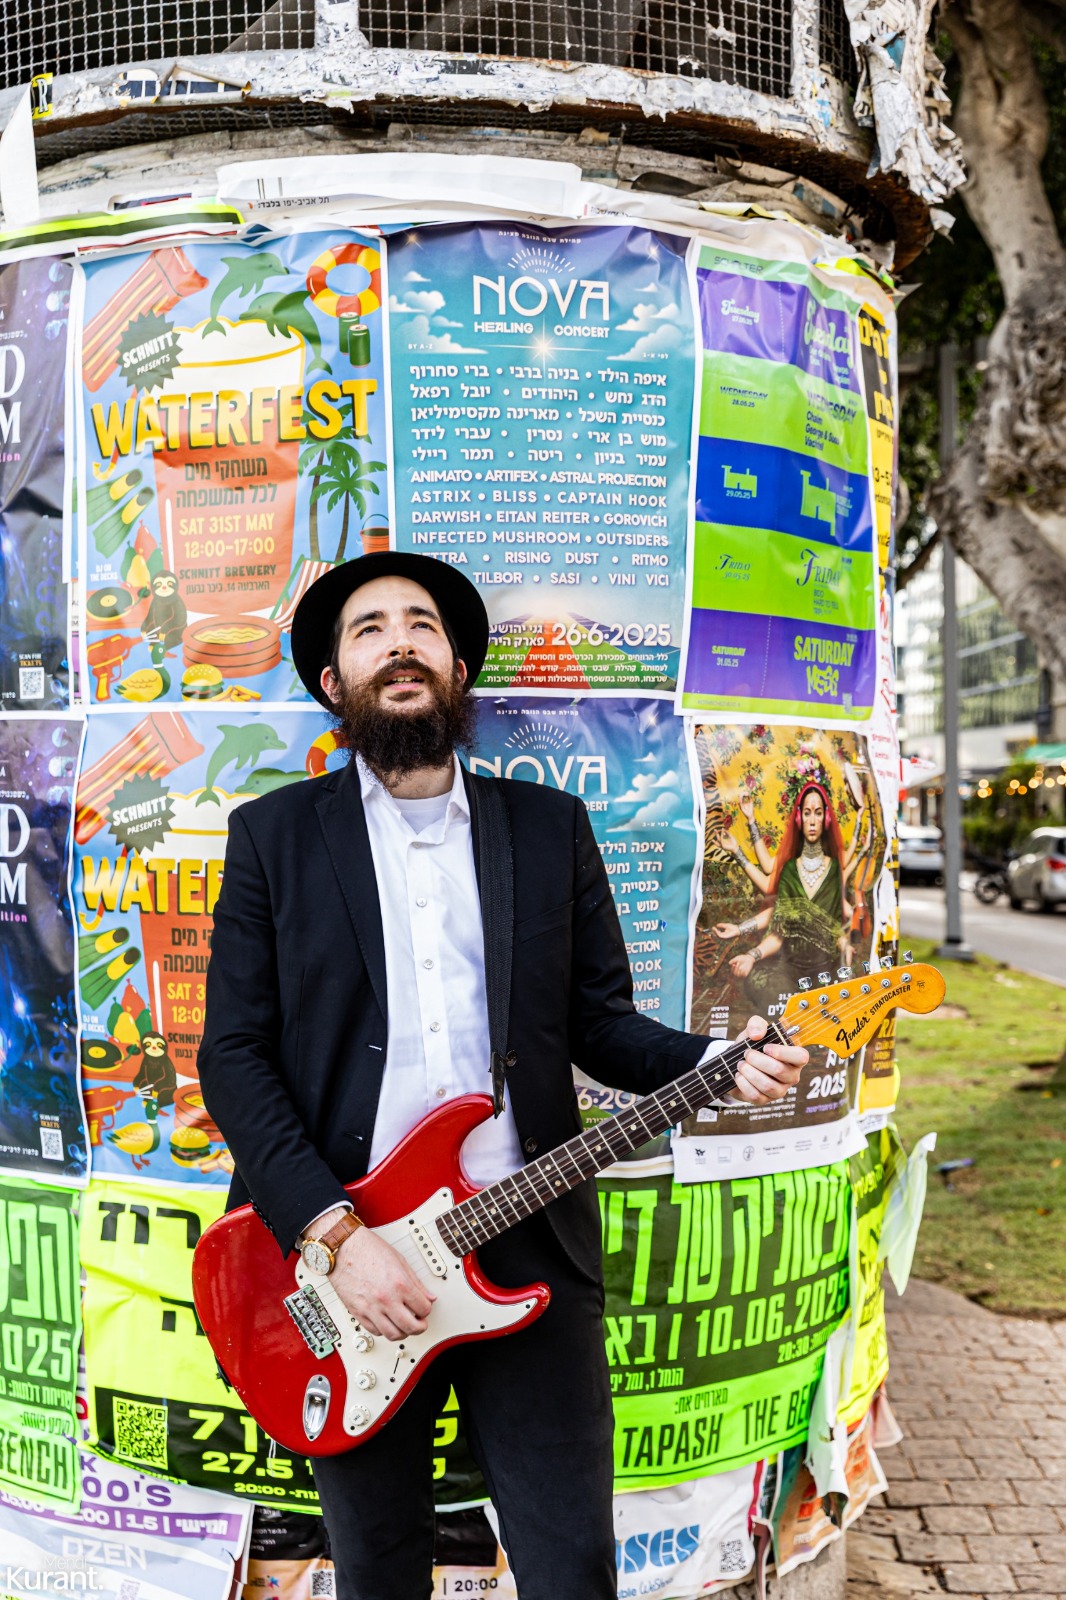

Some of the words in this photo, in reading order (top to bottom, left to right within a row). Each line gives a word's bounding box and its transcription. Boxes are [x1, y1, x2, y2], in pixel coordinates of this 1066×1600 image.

[283, 197, 317, 207] אביב-יפו
[318, 196, 330, 204] תל
[473, 275, 610, 320] NOVA
[474, 321, 534, 334] HEALING
[553, 324, 610, 339] CONCERT
[122, 331, 174, 369] SCHNITT
[136, 353, 171, 376] PRESENTS
[409, 365, 459, 379] סחרוף
[464, 364, 490, 378] ברי
[509, 366, 543, 380] ברבי
[548, 367, 580, 381] בניה
[598, 368, 629, 384] הילד
[633, 371, 667, 386] איפה
[409, 383, 450, 399] רפאל
[460, 383, 491, 399] יובל
[521, 388, 579, 401] היהודים
[720, 386, 768, 400] WEDNESDAY
[605, 392, 633, 406] נחש
[641, 393, 667, 407] הדג
[91, 379, 378, 460] WATERFEST
[410, 403, 501, 422] מקסימיליאן
[506, 406, 560, 421] מארינה
[578, 408, 617, 425] השכל
[621, 413, 666, 427] כנסיית
[411, 424, 446, 441] לידר
[455, 426, 491, 441] עברי
[526, 428, 563, 443] נסרין
[587, 430, 610, 444] ארי
[618, 433, 634, 447] בן
[640, 433, 667, 447] מוש
[412, 445, 448, 461] ריילי
[460, 446, 494, 461] תמר
[527, 448, 563, 462] ריטה
[594, 451, 626, 466] בניון
[636, 453, 667, 468] עמיר
[184, 460, 212, 482] מים
[215, 457, 268, 479] משחקי
[410, 470, 473, 483] ANIMATO
[484, 470, 538, 483] ARTIFEX
[549, 471, 596, 485] ASTRAL
[598, 472, 667, 488] PROJECTION
[176, 486, 245, 508] המשפחה
[249, 482, 278, 505] לכל
[410, 490, 472, 504] ASTRIX
[492, 490, 538, 503] BLISS
[557, 491, 623, 505] CAPTAIN
[628, 493, 667, 508] HOOK
[179, 515, 206, 536] SAT
[208, 514, 241, 534] 31ST
[245, 512, 275, 532] MAY
[412, 510, 481, 524] DARWISH
[496, 511, 537, 524] EITAN
[542, 512, 590, 525] REITER
[603, 513, 668, 528] GOROVICH
[412, 531, 487, 545] INFECTED
[492, 531, 581, 545] MUSHROOM
[596, 533, 669, 547] OUTSIDERS
[184, 536, 275, 559] 12:00-17:00
[504, 552, 551, 565] RISING
[565, 552, 599, 566] DUST
[631, 554, 669, 567] RITMO
[179, 567, 221, 580] SCHNITT
[225, 564, 277, 577] BREWERY
[472, 571, 523, 584] TILBOR
[550, 572, 580, 585] SASI
[608, 573, 636, 586] VINI
[646, 574, 669, 587] VICI
[186, 583, 205, 595] גבעון
[207, 582, 223, 593] כיכר
[237, 580, 270, 591] הארבעה
[488, 624, 527, 634] יהושע
[531, 624, 544, 634] גני
[514, 636, 545, 647] פארק
[498, 654, 526, 662] האירוע
[529, 654, 556, 662] וחסויות
[558, 654, 594, 662] הכרטיסים
[596, 654, 625, 662] ממכירת
[711, 645, 746, 657] SATURDAY
[793, 635, 855, 667] SATURDAY
[540, 664, 559, 673] קודש
[592, 664, 609, 672] שבט
[614, 664, 637, 673] קהילת
[523, 674, 547, 683] ושורדי
[547, 674, 578, 683] השכולות
[579, 675, 616, 683] במשפחות
[616, 675, 640, 683] תמיכה
[112, 796, 168, 827] SCHNITT
[127, 817, 163, 836] PRESENTS
[631, 840, 665, 853] איפה
[637, 861, 663, 873] הדג
[621, 879, 660, 893] כנסיית
[637, 900, 659, 912] מוש
[632, 920, 659, 933] עמיר
[171, 928, 198, 947] מים
[167, 983, 191, 1001] SAT
[869, 984, 911, 1016] STRATOCASTER
[836, 1015, 871, 1050] Fender
[806, 1069, 847, 1099] 2025
[667, 1181, 723, 1305] של
[695, 1269, 848, 1358] 10.06.2025
[777, 1335, 810, 1364] 20:30
[625, 1371, 645, 1391] נמל
[657, 1367, 684, 1388] הנמל
[674, 1395, 693, 1415] את:
[694, 1387, 728, 1411] מארחים
[622, 1412, 723, 1468] TAPASH
[742, 1394, 781, 1446] THE
[202, 1450, 294, 1480] 27.5
[234, 1482, 286, 1496] 20:00
[126, 1514, 159, 1531] 1.5
[175, 1518, 229, 1535] חמישי
[61, 1535, 147, 1571] DZEN
[454, 1577, 499, 1593] 20:00
